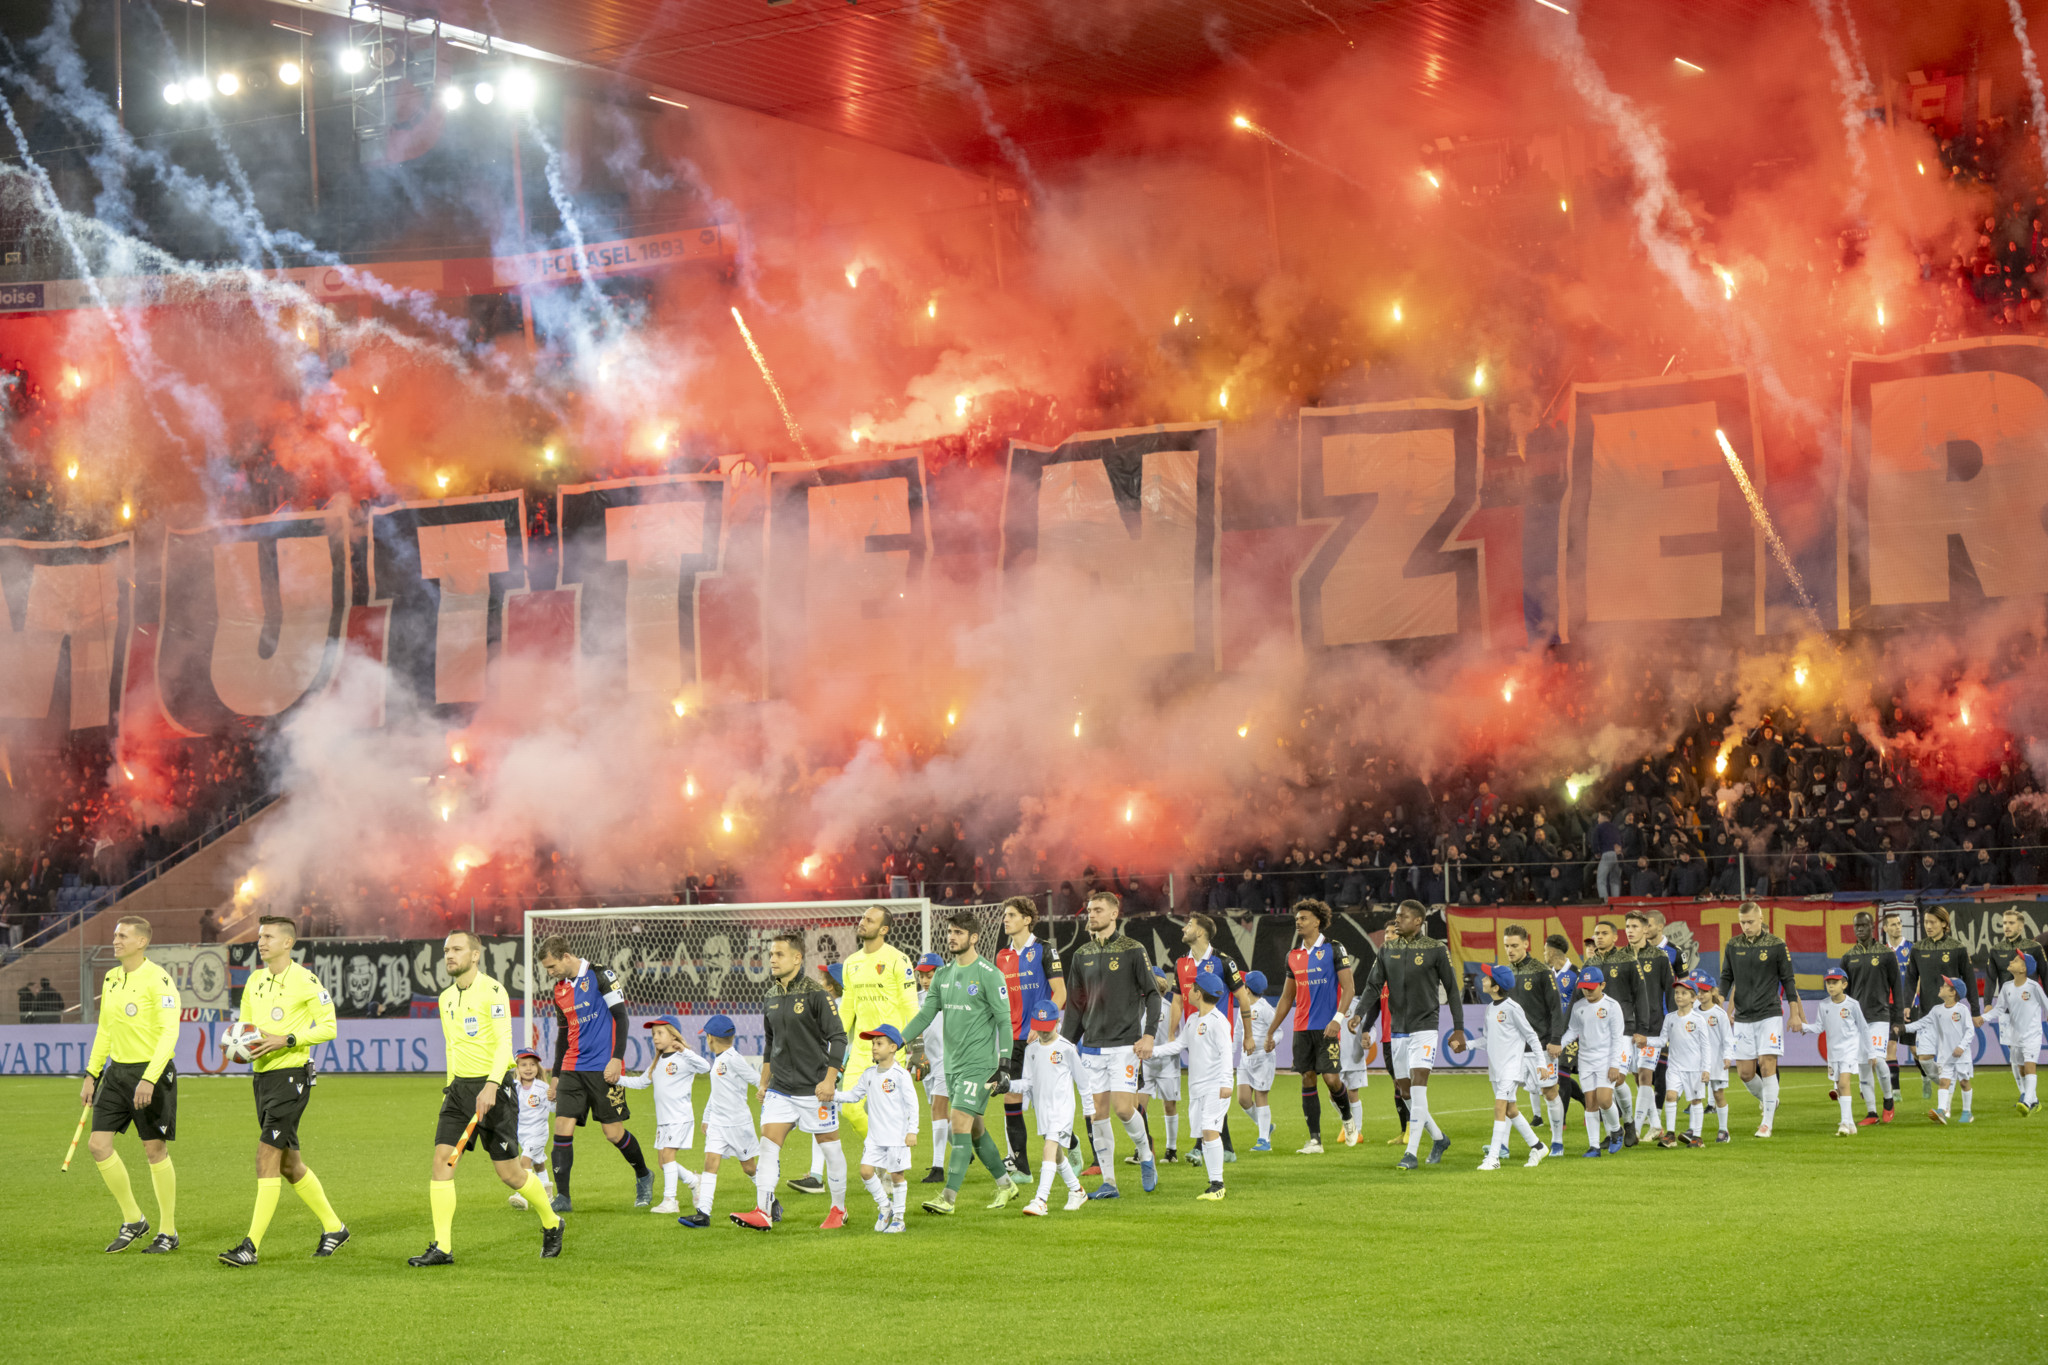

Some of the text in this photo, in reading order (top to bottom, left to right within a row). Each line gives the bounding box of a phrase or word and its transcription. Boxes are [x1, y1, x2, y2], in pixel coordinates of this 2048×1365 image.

[542, 238, 685, 275] FC BASEL 1893
[1010, 982, 1039, 992] NOVARTIS
[1298, 977, 1328, 986] NOVARTIS
[1872, 1036, 1882, 1046] 21
[1423, 1045, 1431, 1057] 7
[1125, 1064, 1134, 1078] 9
[963, 1080, 978, 1097] 71
